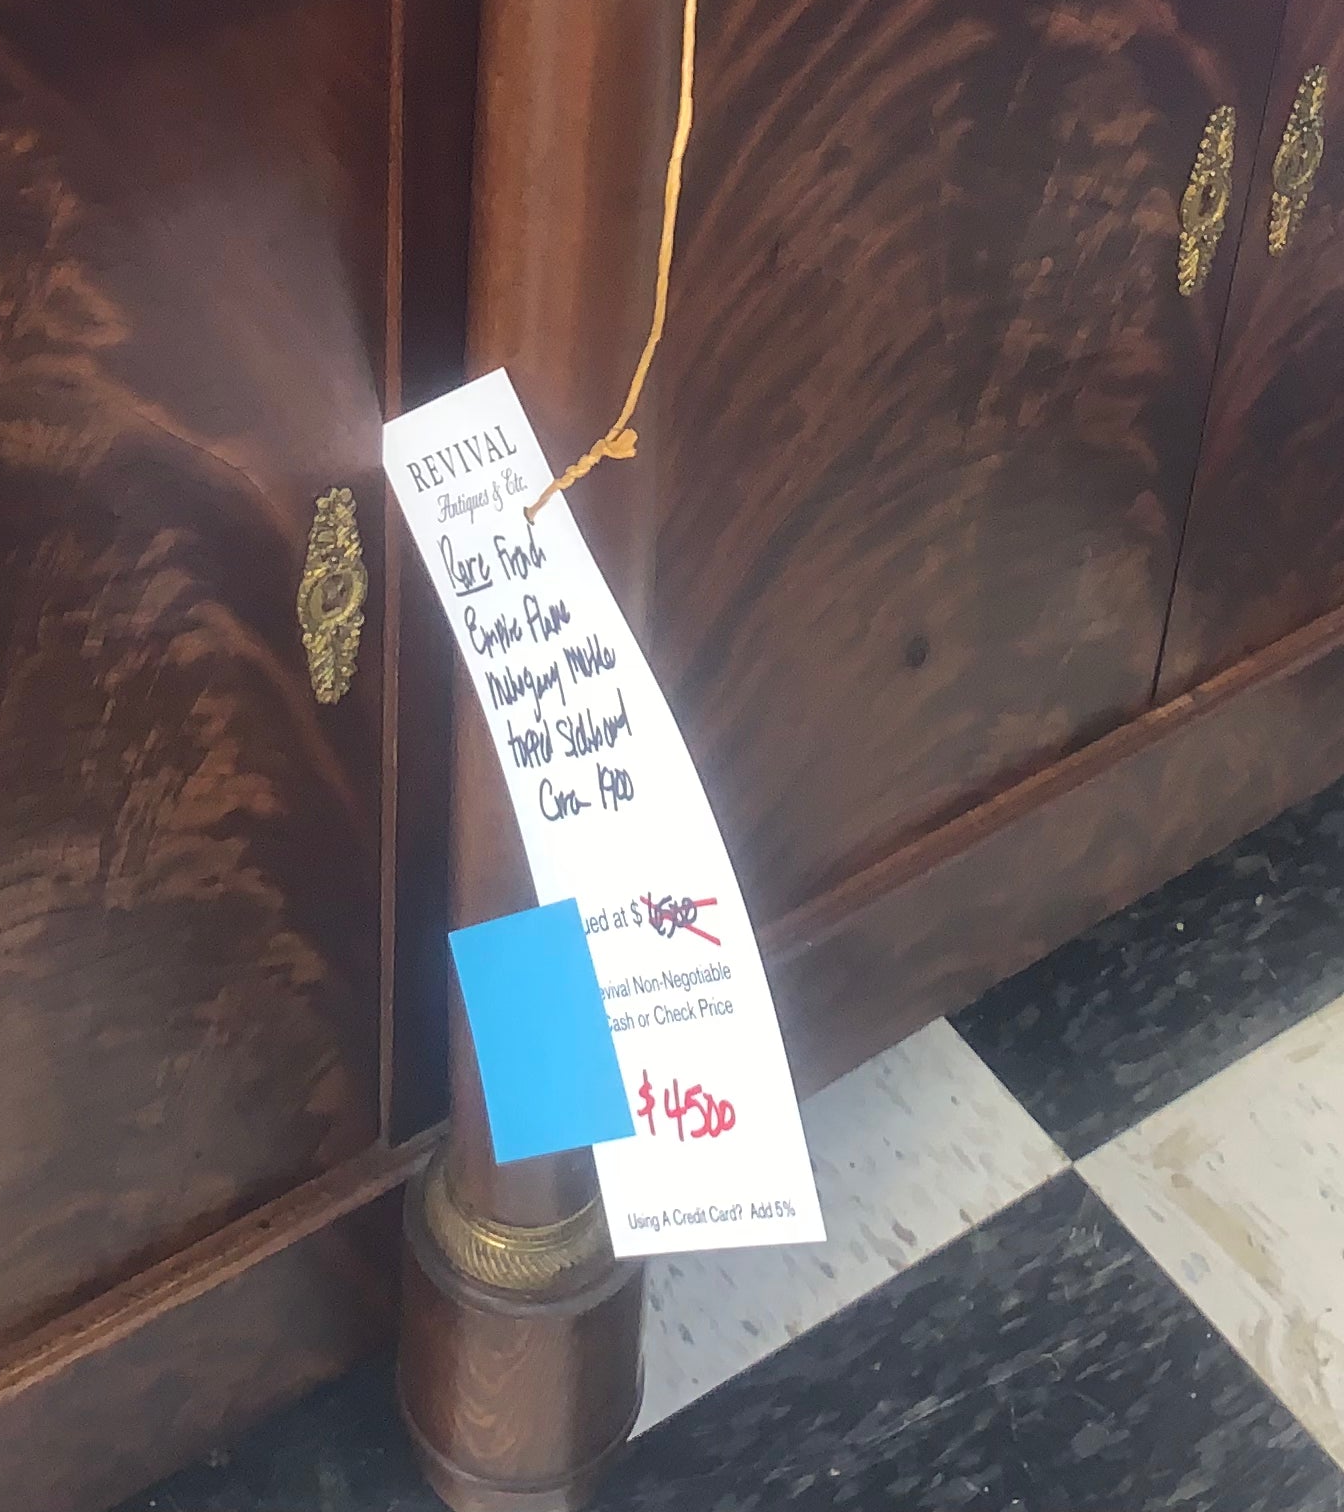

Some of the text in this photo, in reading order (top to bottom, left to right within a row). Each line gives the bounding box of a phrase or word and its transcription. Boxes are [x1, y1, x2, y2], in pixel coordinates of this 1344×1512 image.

[406, 425, 517, 493] REVIVAL
[437, 493, 489, 524] Antiques
[501, 468, 528, 495] Etc.
[437, 535, 492, 591] Rare
[464, 605, 522, 659] Empire
[596, 762, 634, 812] 1900
[585, 908, 609, 935] ued
[613, 907, 629, 928] at
[599, 961, 732, 1001] evival Non-Negotiable
[638, 1013, 650, 1028] or
[654, 1001, 697, 1025] Check
[698, 998, 734, 1018] Price
[628, 1199, 796, 1232] Using A Credit Card? Add 5%
